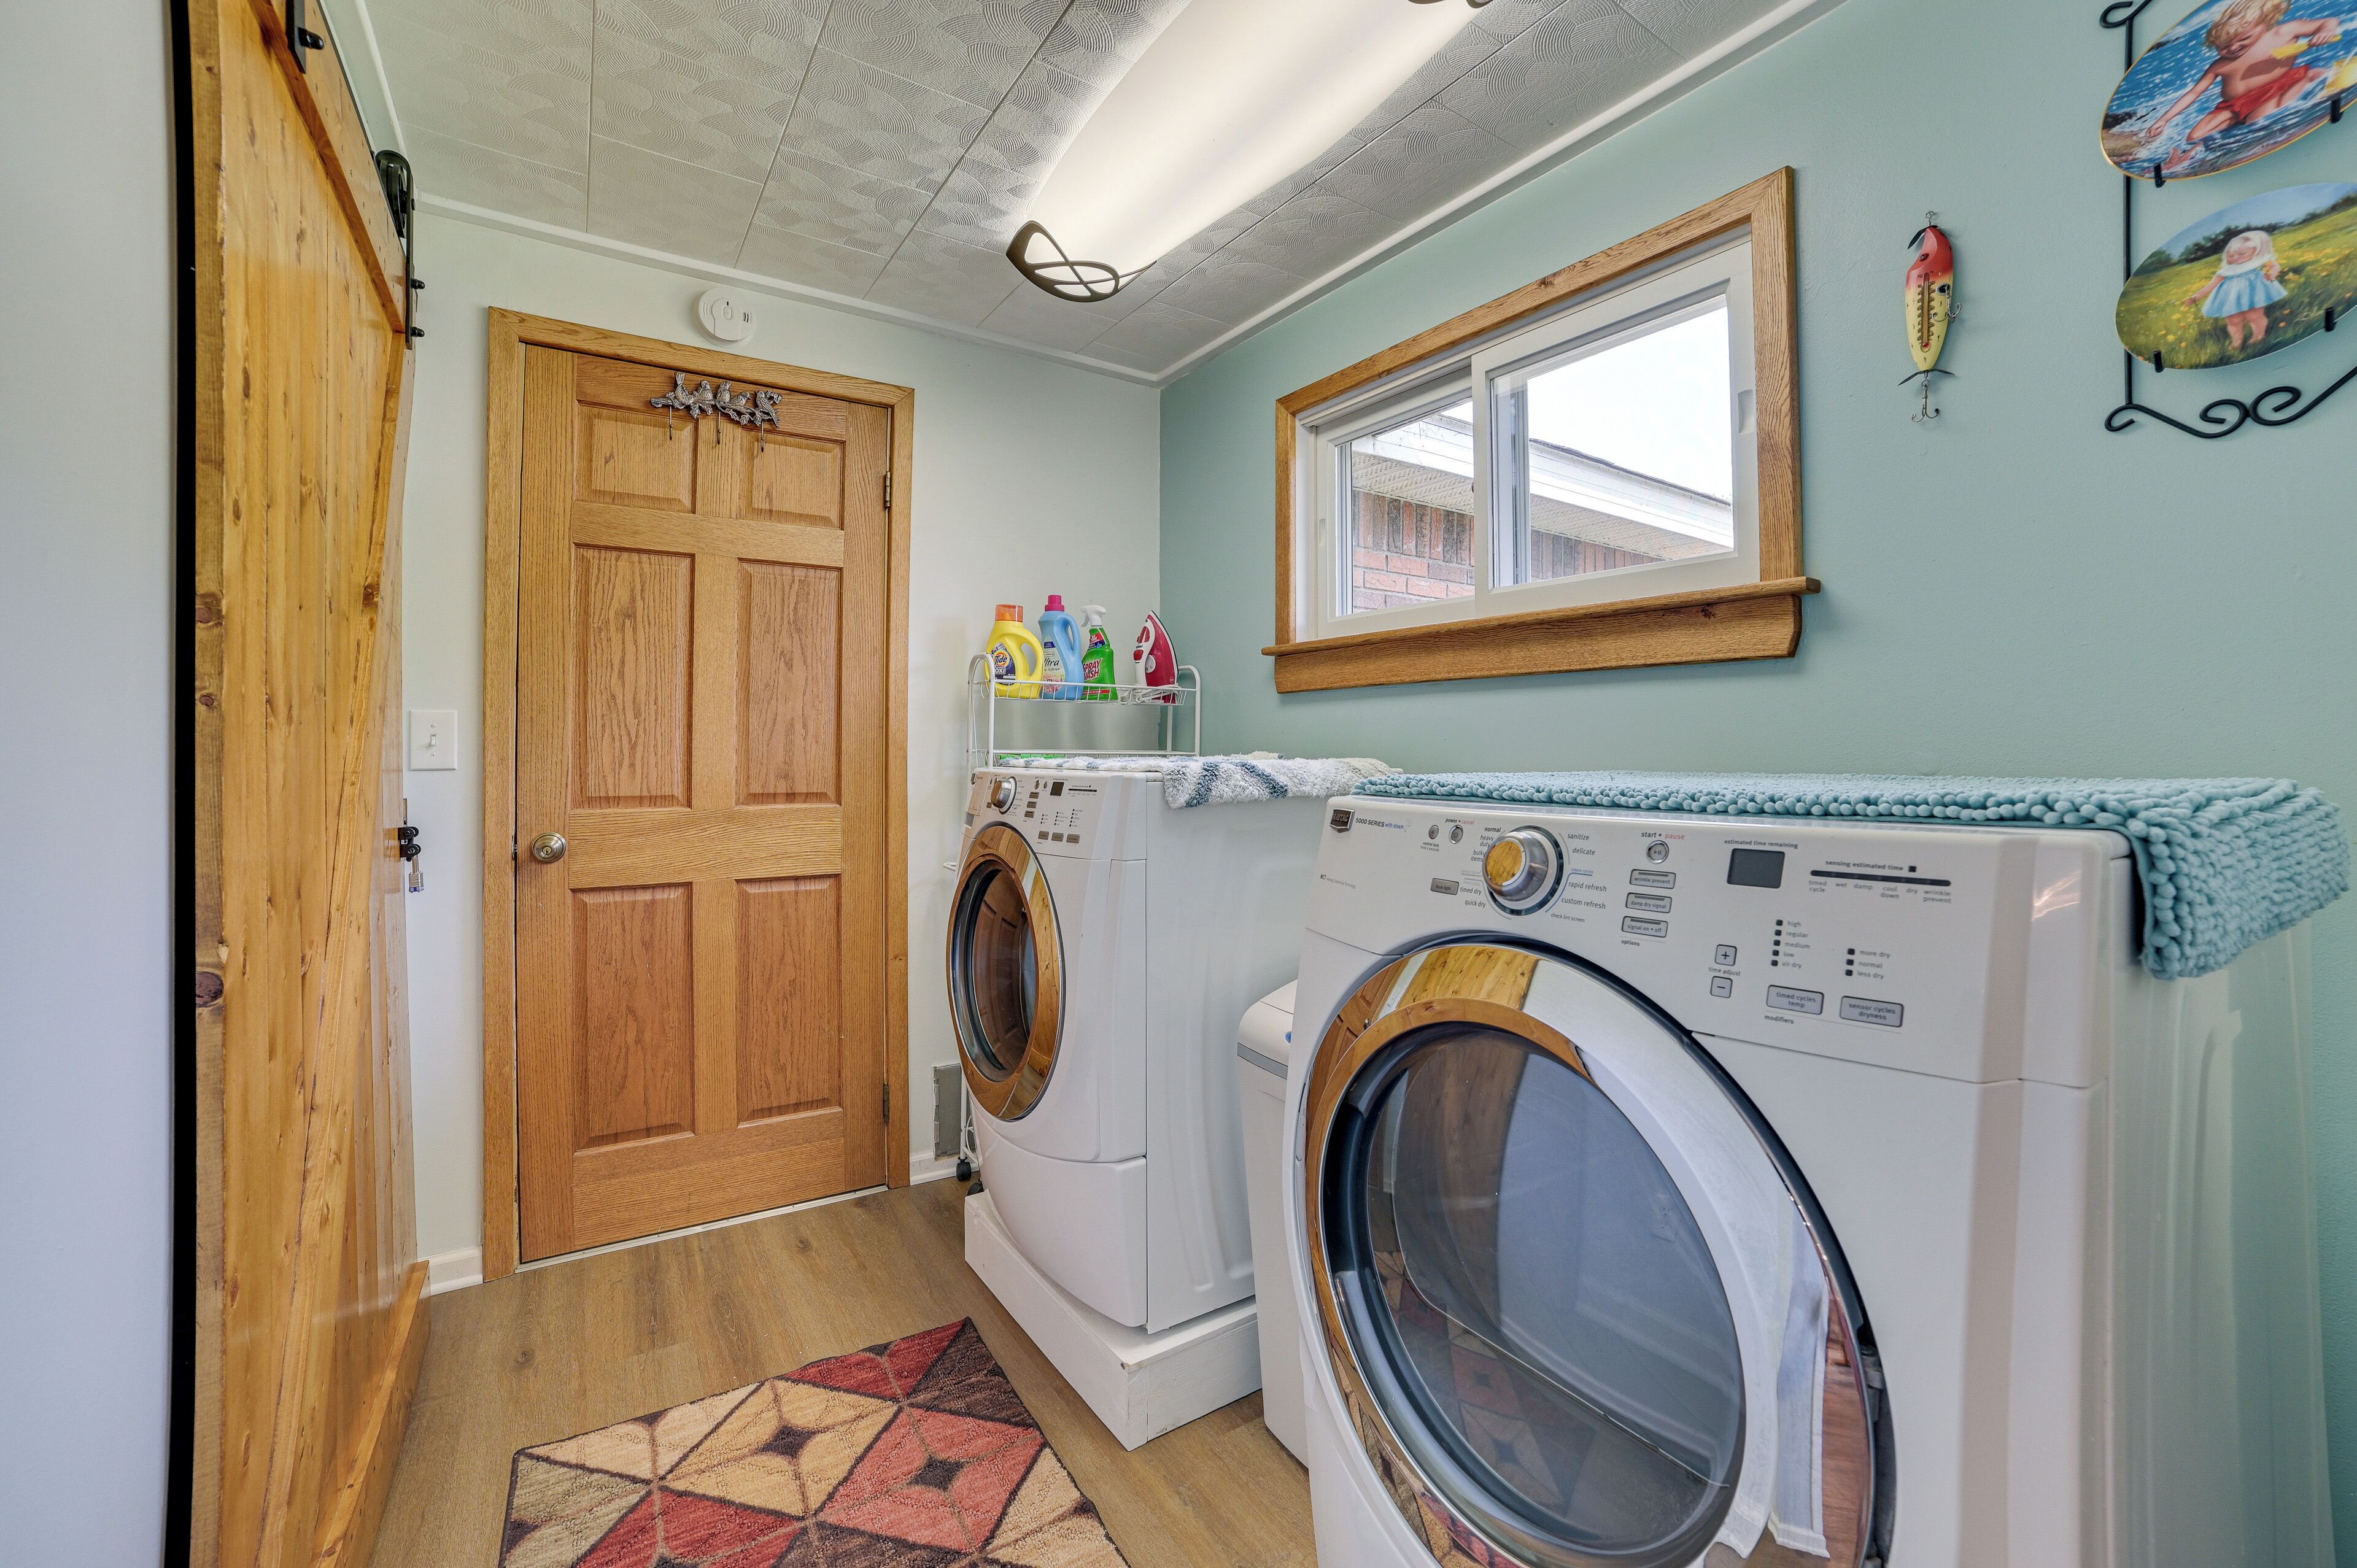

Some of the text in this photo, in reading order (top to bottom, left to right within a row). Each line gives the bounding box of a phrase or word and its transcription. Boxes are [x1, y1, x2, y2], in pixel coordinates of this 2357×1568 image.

[994, 655, 1008, 665] Tide
[1083, 658, 1102, 672] SPRAY
[1333, 813, 1349, 822] MAYTAG
[1572, 847, 1596, 855] delicate
[1825, 860, 1851, 868] sensing
[1852, 862, 1886, 870] estimated
[1585, 883, 1607, 892] refresh
[1853, 882, 1873, 891] damp
[1477, 900, 1487, 909] dry
[1561, 897, 1606, 910] custom refresh
[1784, 941, 1810, 949] medium
[1858, 960, 1883, 969] normal
[1723, 968, 1741, 977] adjust
[1873, 971, 1885, 980] dry
[1776, 992, 1816, 1003] timed cycles
[1788, 1000, 1805, 1009] temp
[1848, 1002, 1896, 1014] sensor cycles
[1764, 1014, 1794, 1025] modifiers
[1858, 1011, 1887, 1021] dryness
